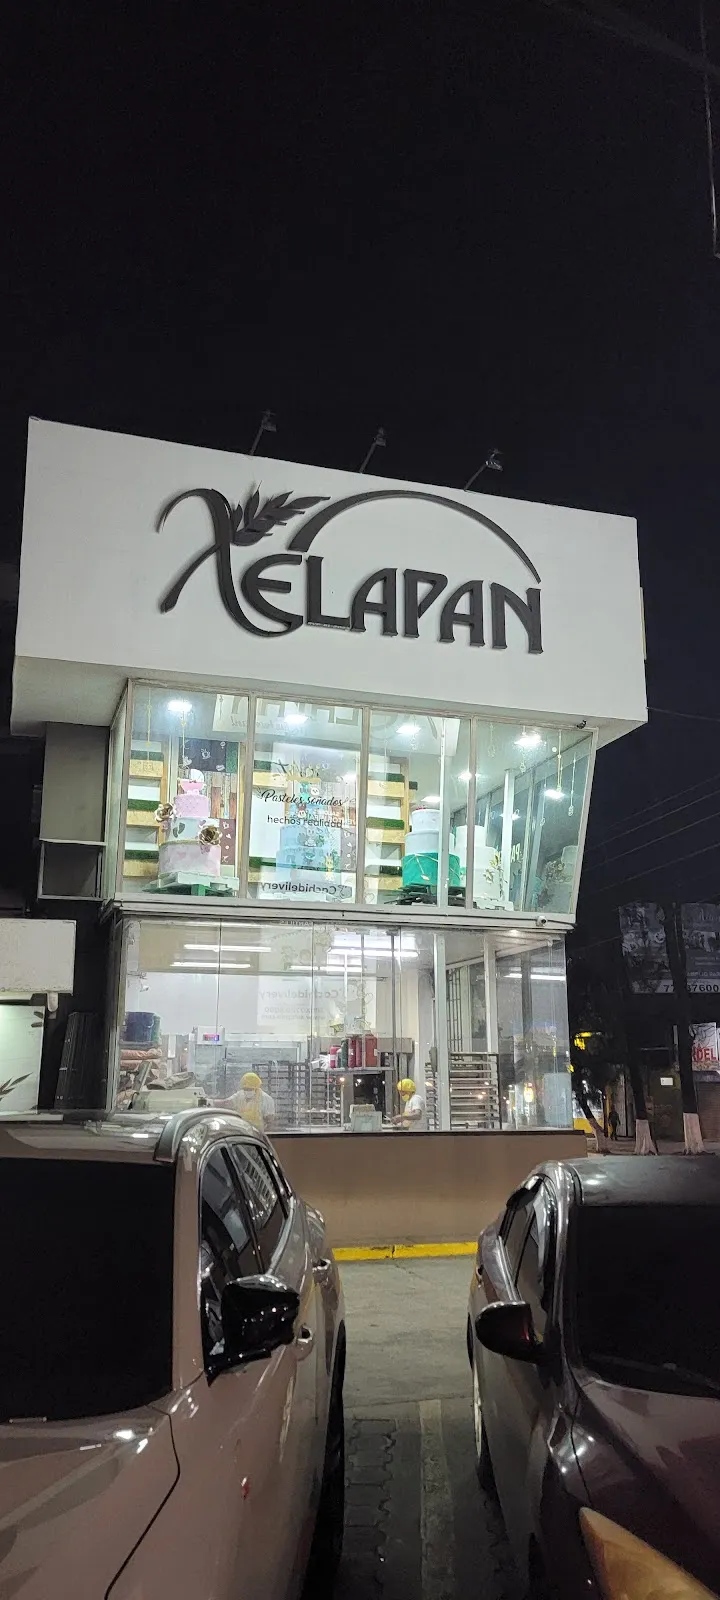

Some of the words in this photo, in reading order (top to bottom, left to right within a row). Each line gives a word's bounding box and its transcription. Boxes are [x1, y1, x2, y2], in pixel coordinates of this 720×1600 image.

[157, 487, 544, 655] XELAPAN
[261, 789, 303, 804] Pasteles
[306, 796, 344, 808] soñados
[267, 815, 301, 826] hechos
[303, 818, 343, 829] realidad
